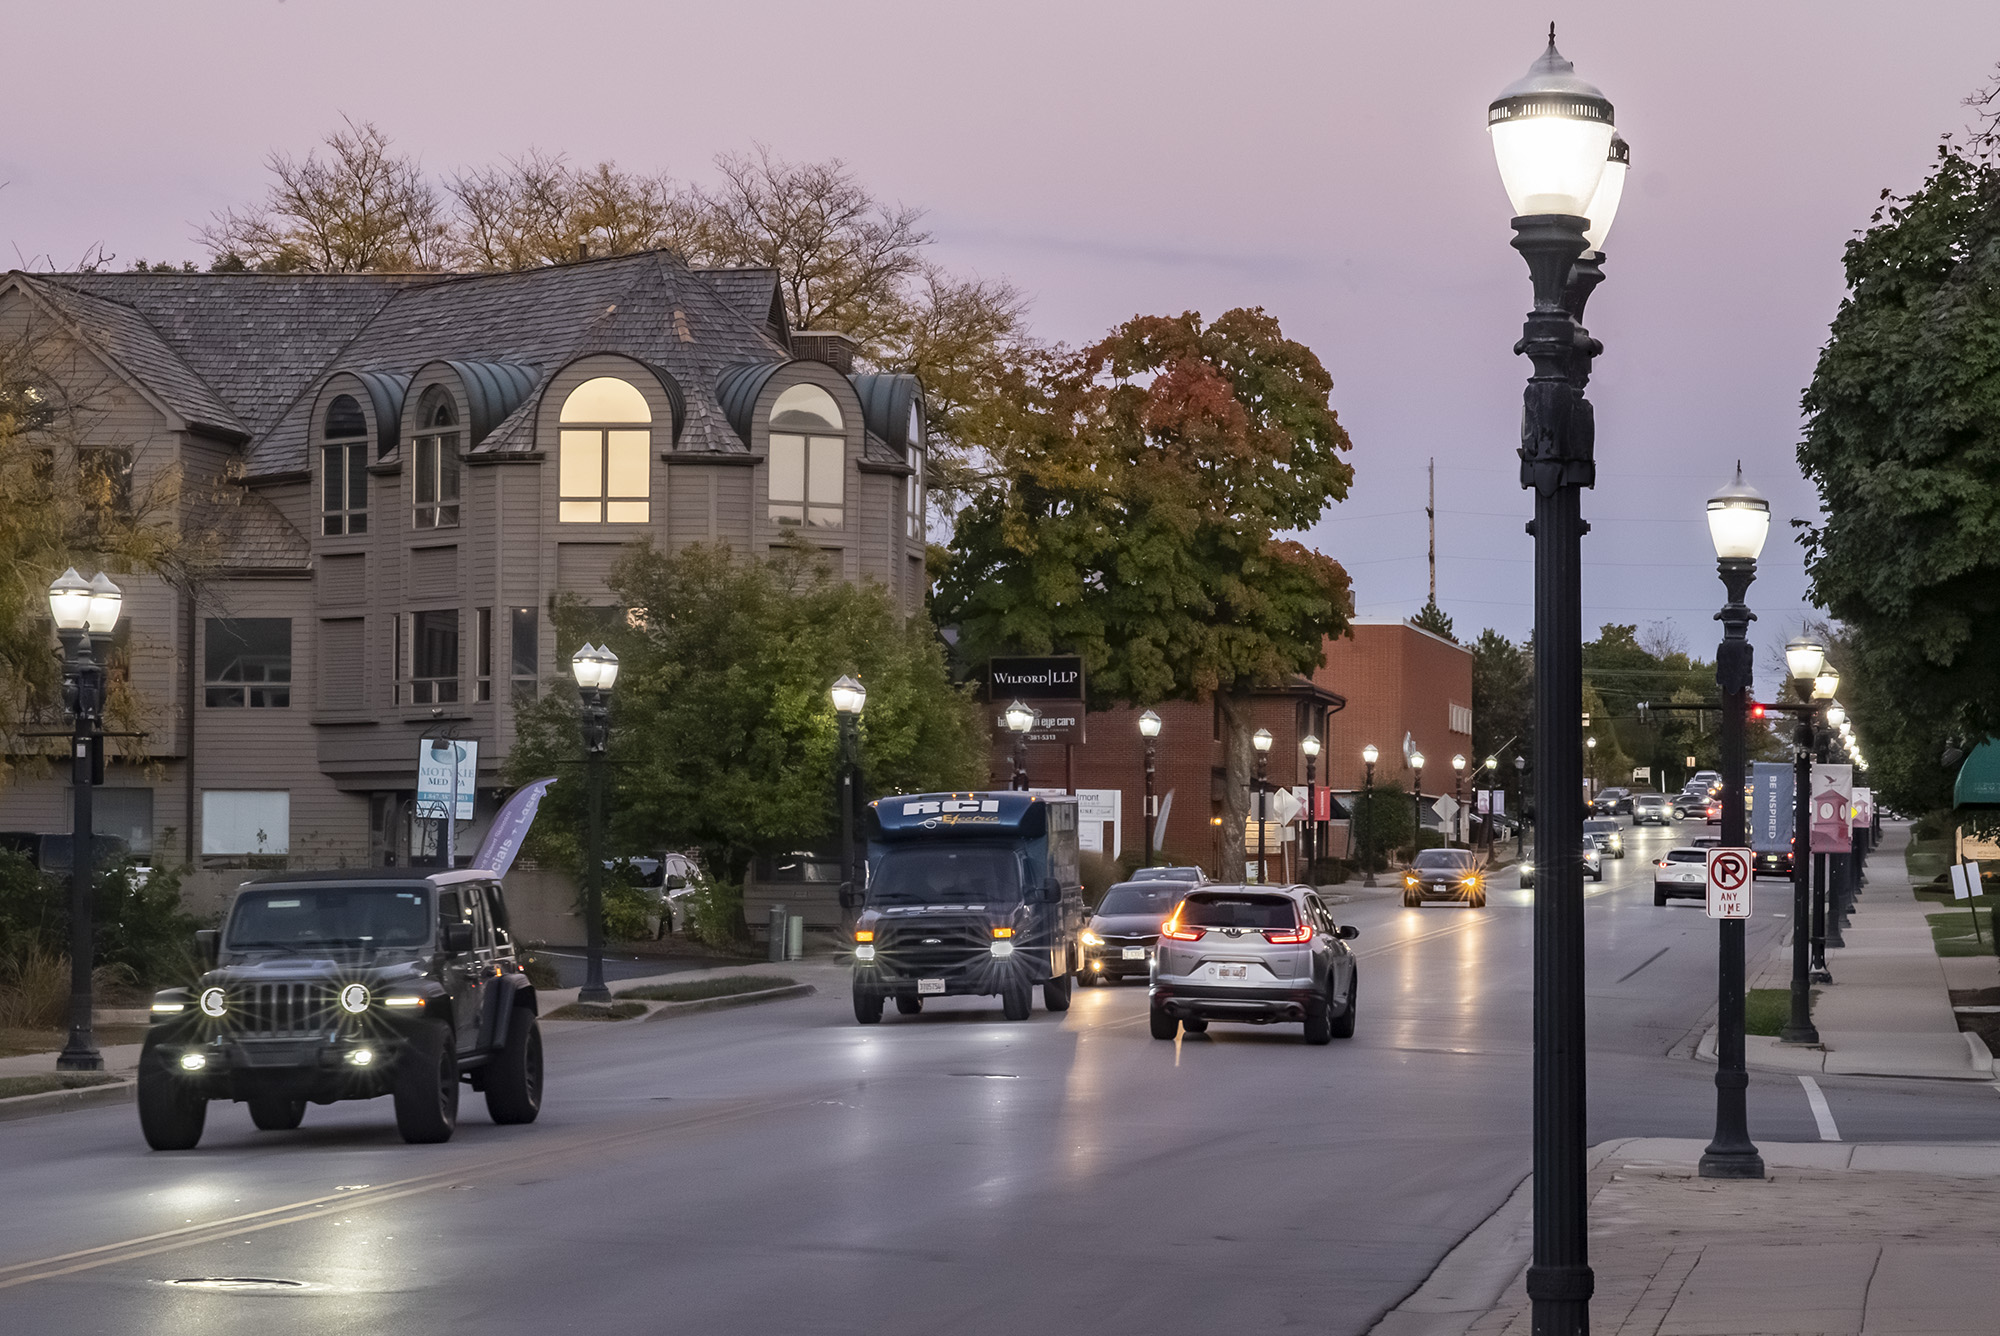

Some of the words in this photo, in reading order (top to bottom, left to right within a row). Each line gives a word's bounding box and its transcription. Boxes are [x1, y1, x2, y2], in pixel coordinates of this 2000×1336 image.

[1041, 717, 1056, 728] eye
[1056, 717, 1075, 726] care
[428, 777, 449, 786] MED
[1769, 775, 1777, 789] BE
[515, 786, 542, 824] Laser
[903, 800, 999, 816] RCI
[942, 814, 999, 826] Electric
[1768, 792, 1776, 839] INSPIRED
[1720, 893, 1738, 901] ANY
